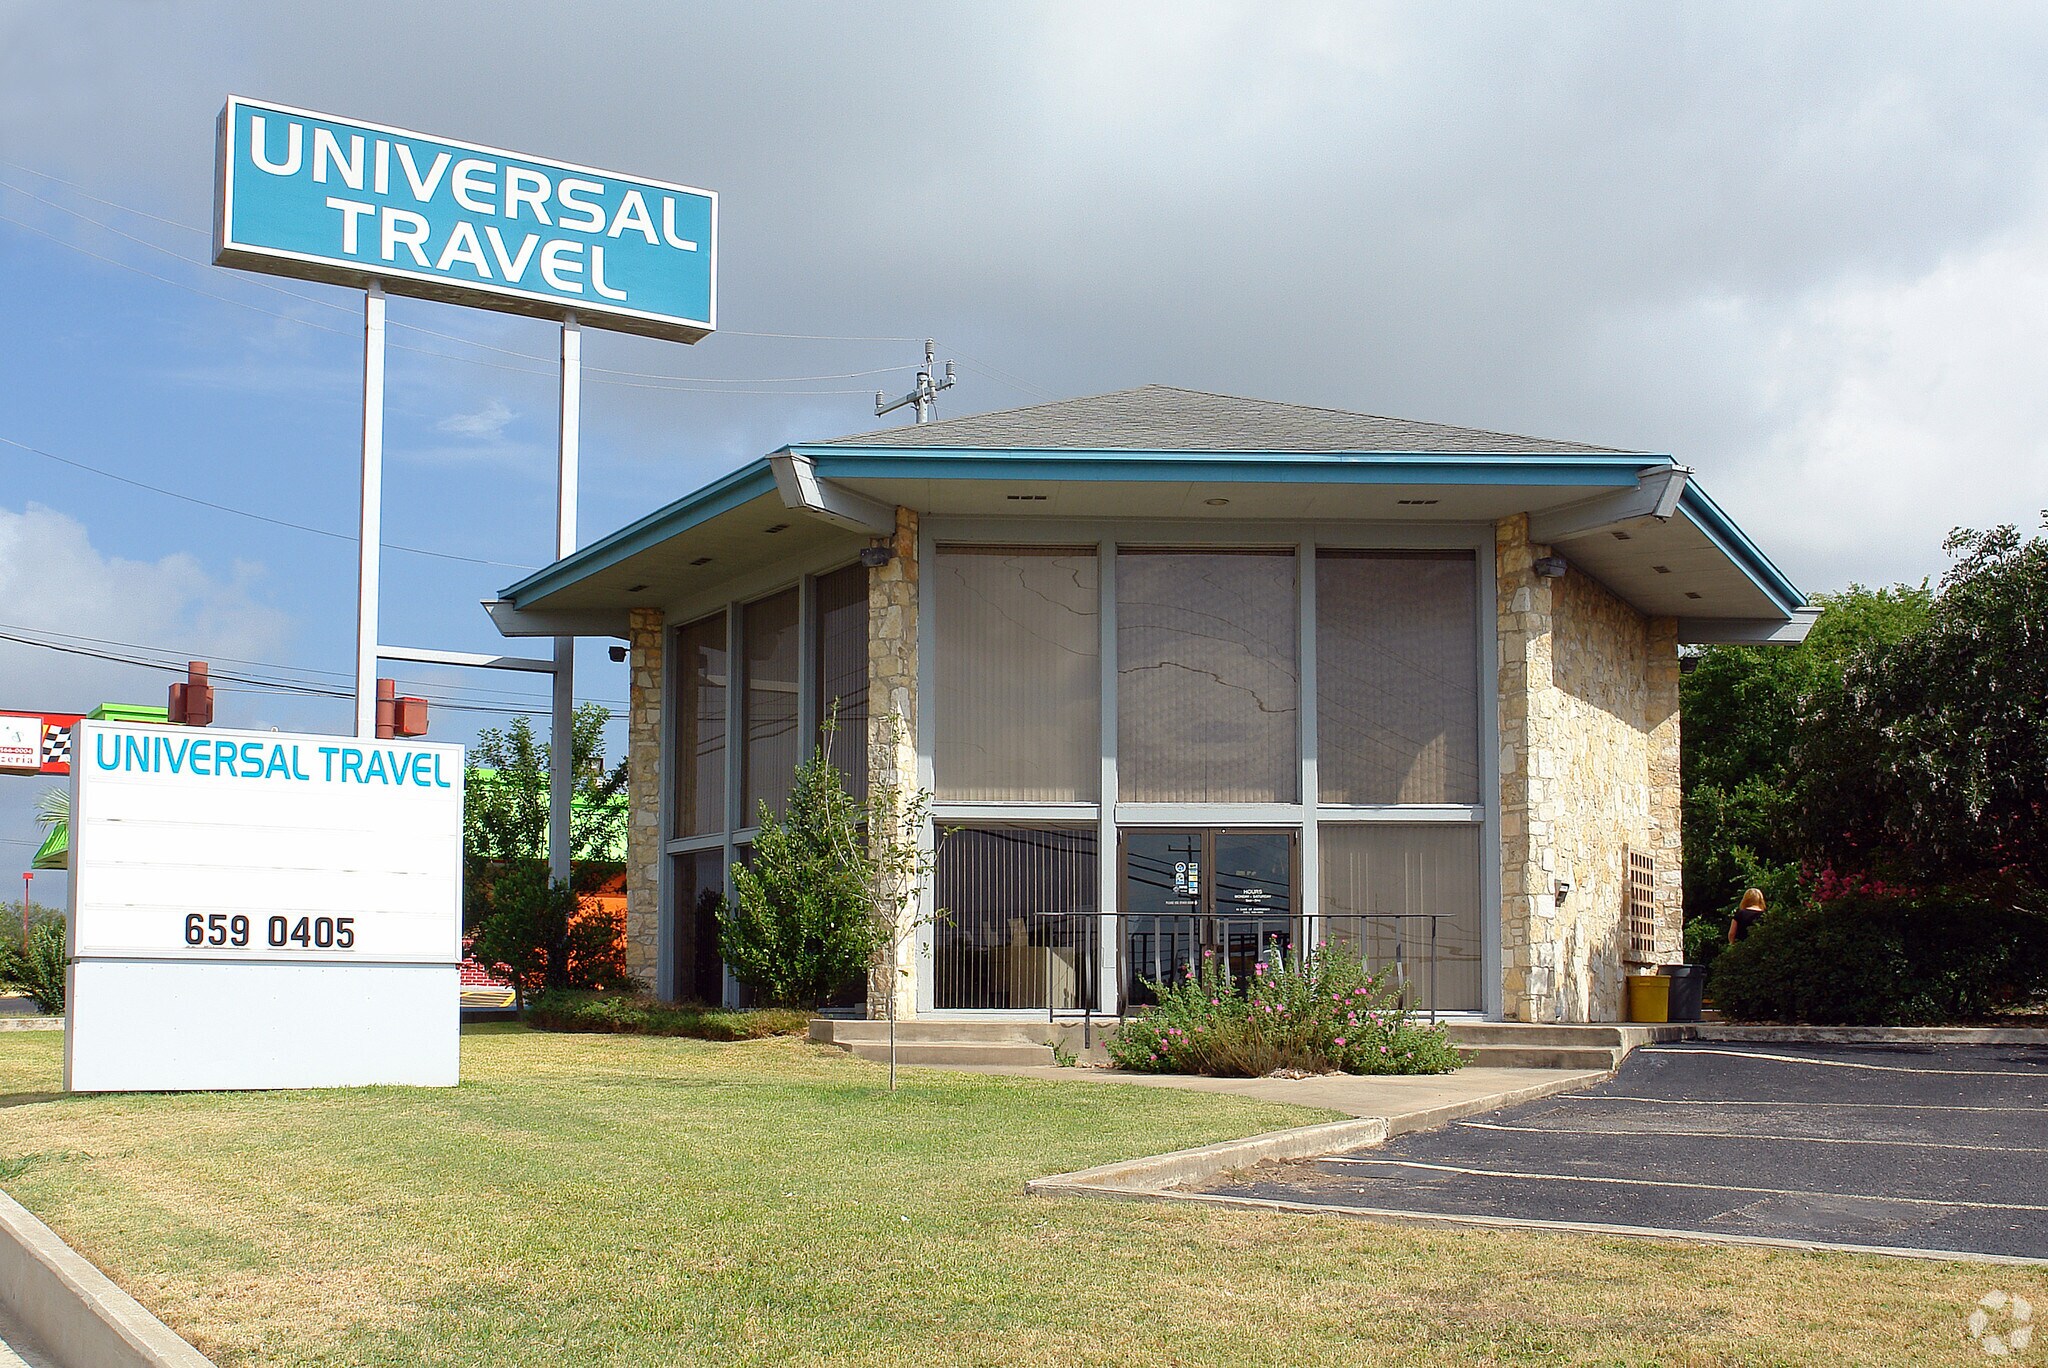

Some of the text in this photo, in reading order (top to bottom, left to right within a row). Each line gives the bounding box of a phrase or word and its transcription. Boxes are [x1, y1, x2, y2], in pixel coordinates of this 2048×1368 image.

[250, 115, 698, 252] UNIVERSAL
[326, 196, 628, 302] TRAVEL
[97, 733, 451, 788] UNIVERSAL TRAVEL
[185, 913, 354, 949] 659 0405
